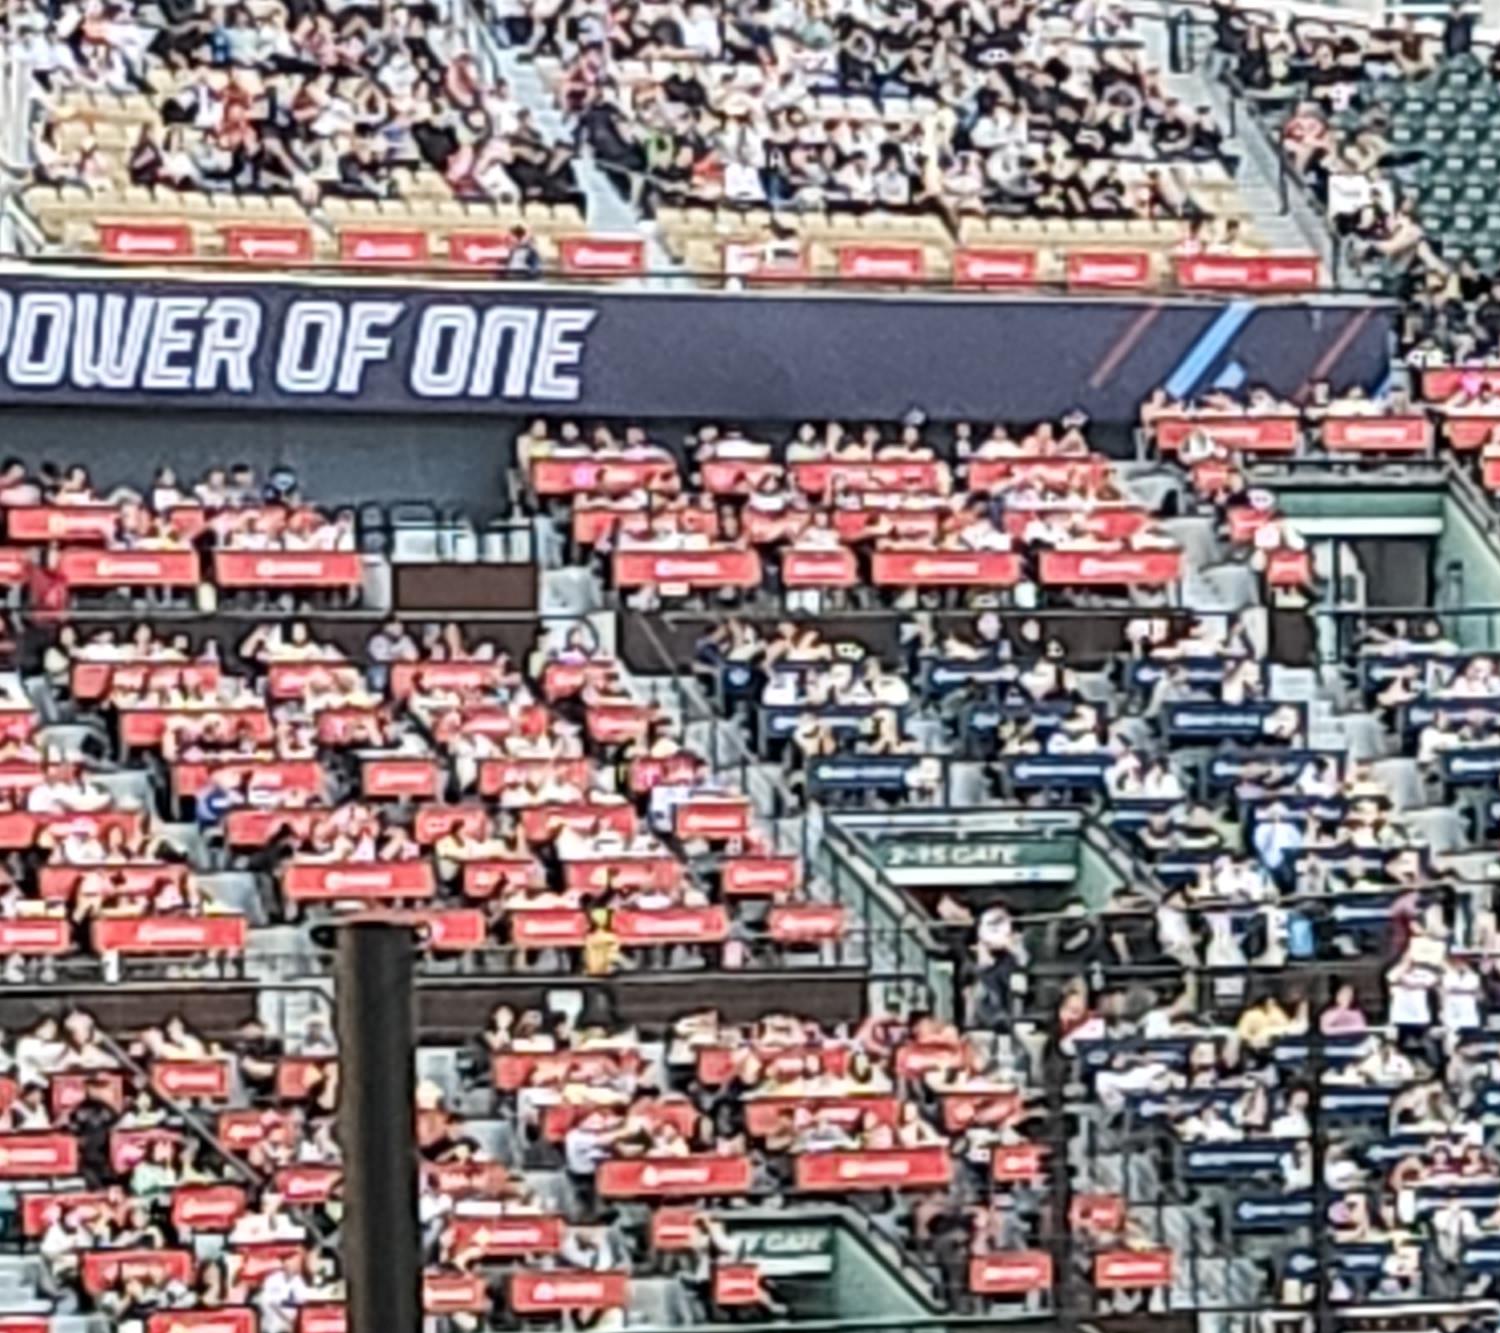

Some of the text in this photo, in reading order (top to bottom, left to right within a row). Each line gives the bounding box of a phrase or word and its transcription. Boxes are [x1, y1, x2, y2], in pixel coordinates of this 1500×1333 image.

[0, 289, 596, 401] OWER OF ONE
